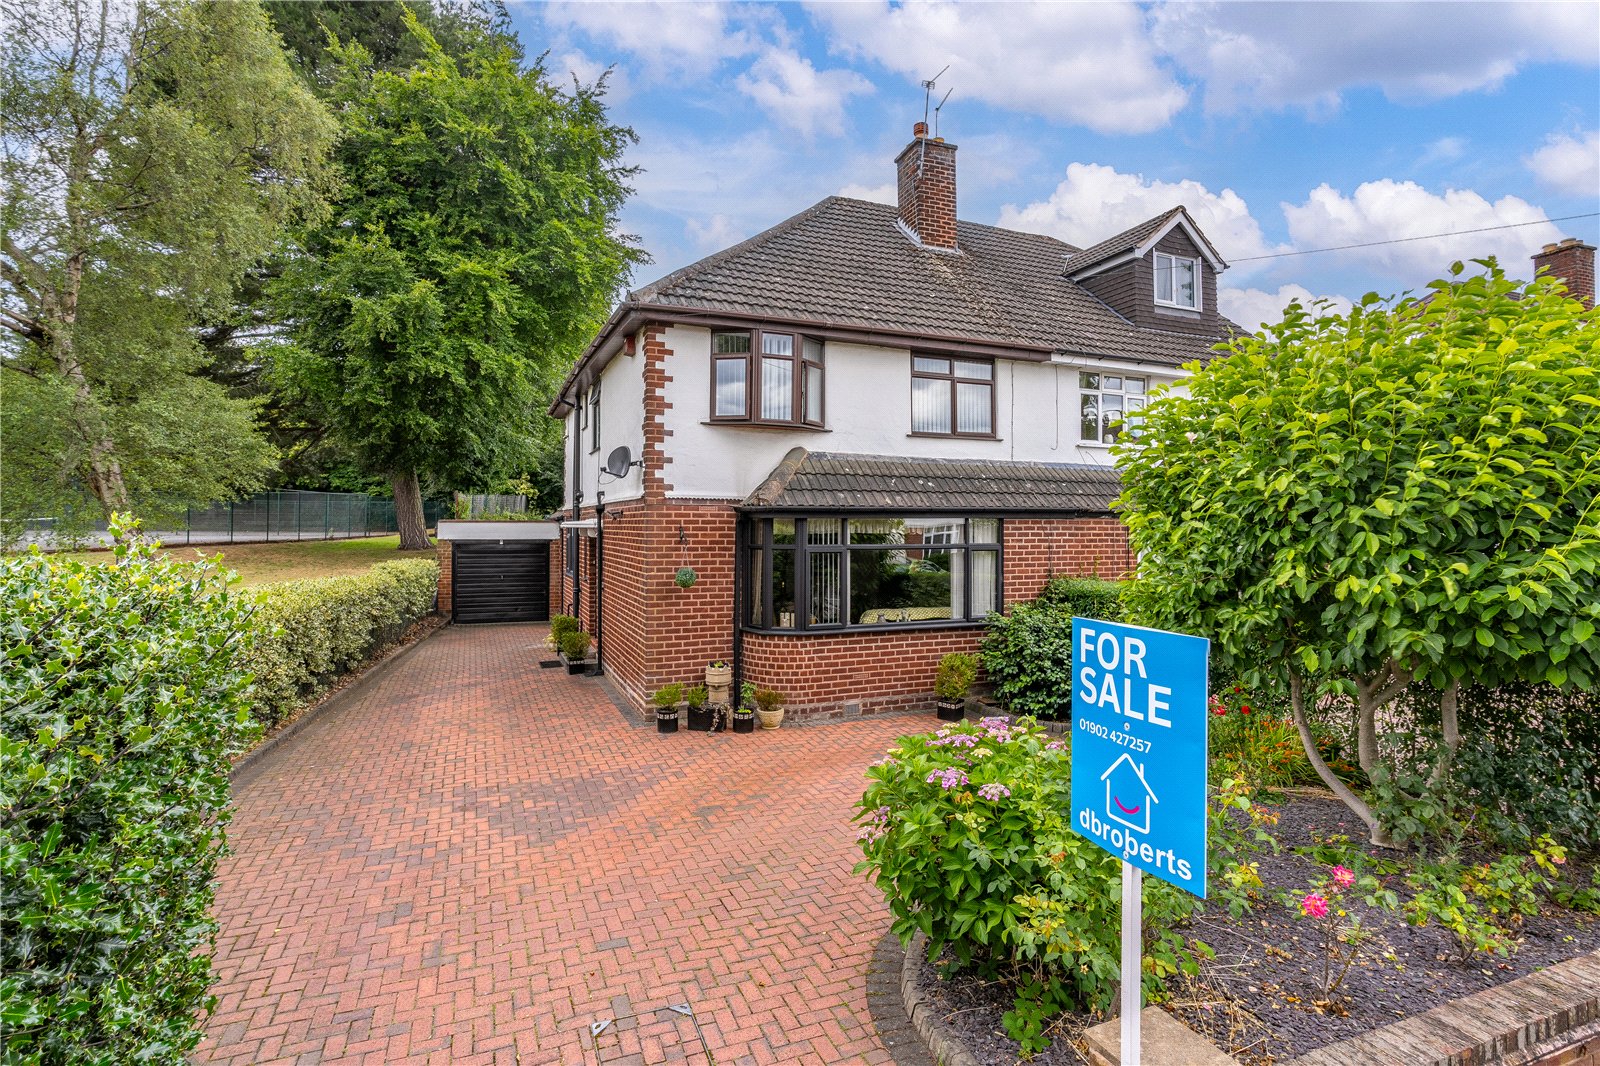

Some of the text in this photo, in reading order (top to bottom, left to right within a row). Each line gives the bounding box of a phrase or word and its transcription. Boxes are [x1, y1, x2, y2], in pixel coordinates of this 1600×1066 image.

[1080, 627, 1147, 679] FOR
[1080, 666, 1172, 728] SALE
[1079, 718, 1152, 754] 01902 427257
[1079, 807, 1192, 880] dbroberts
